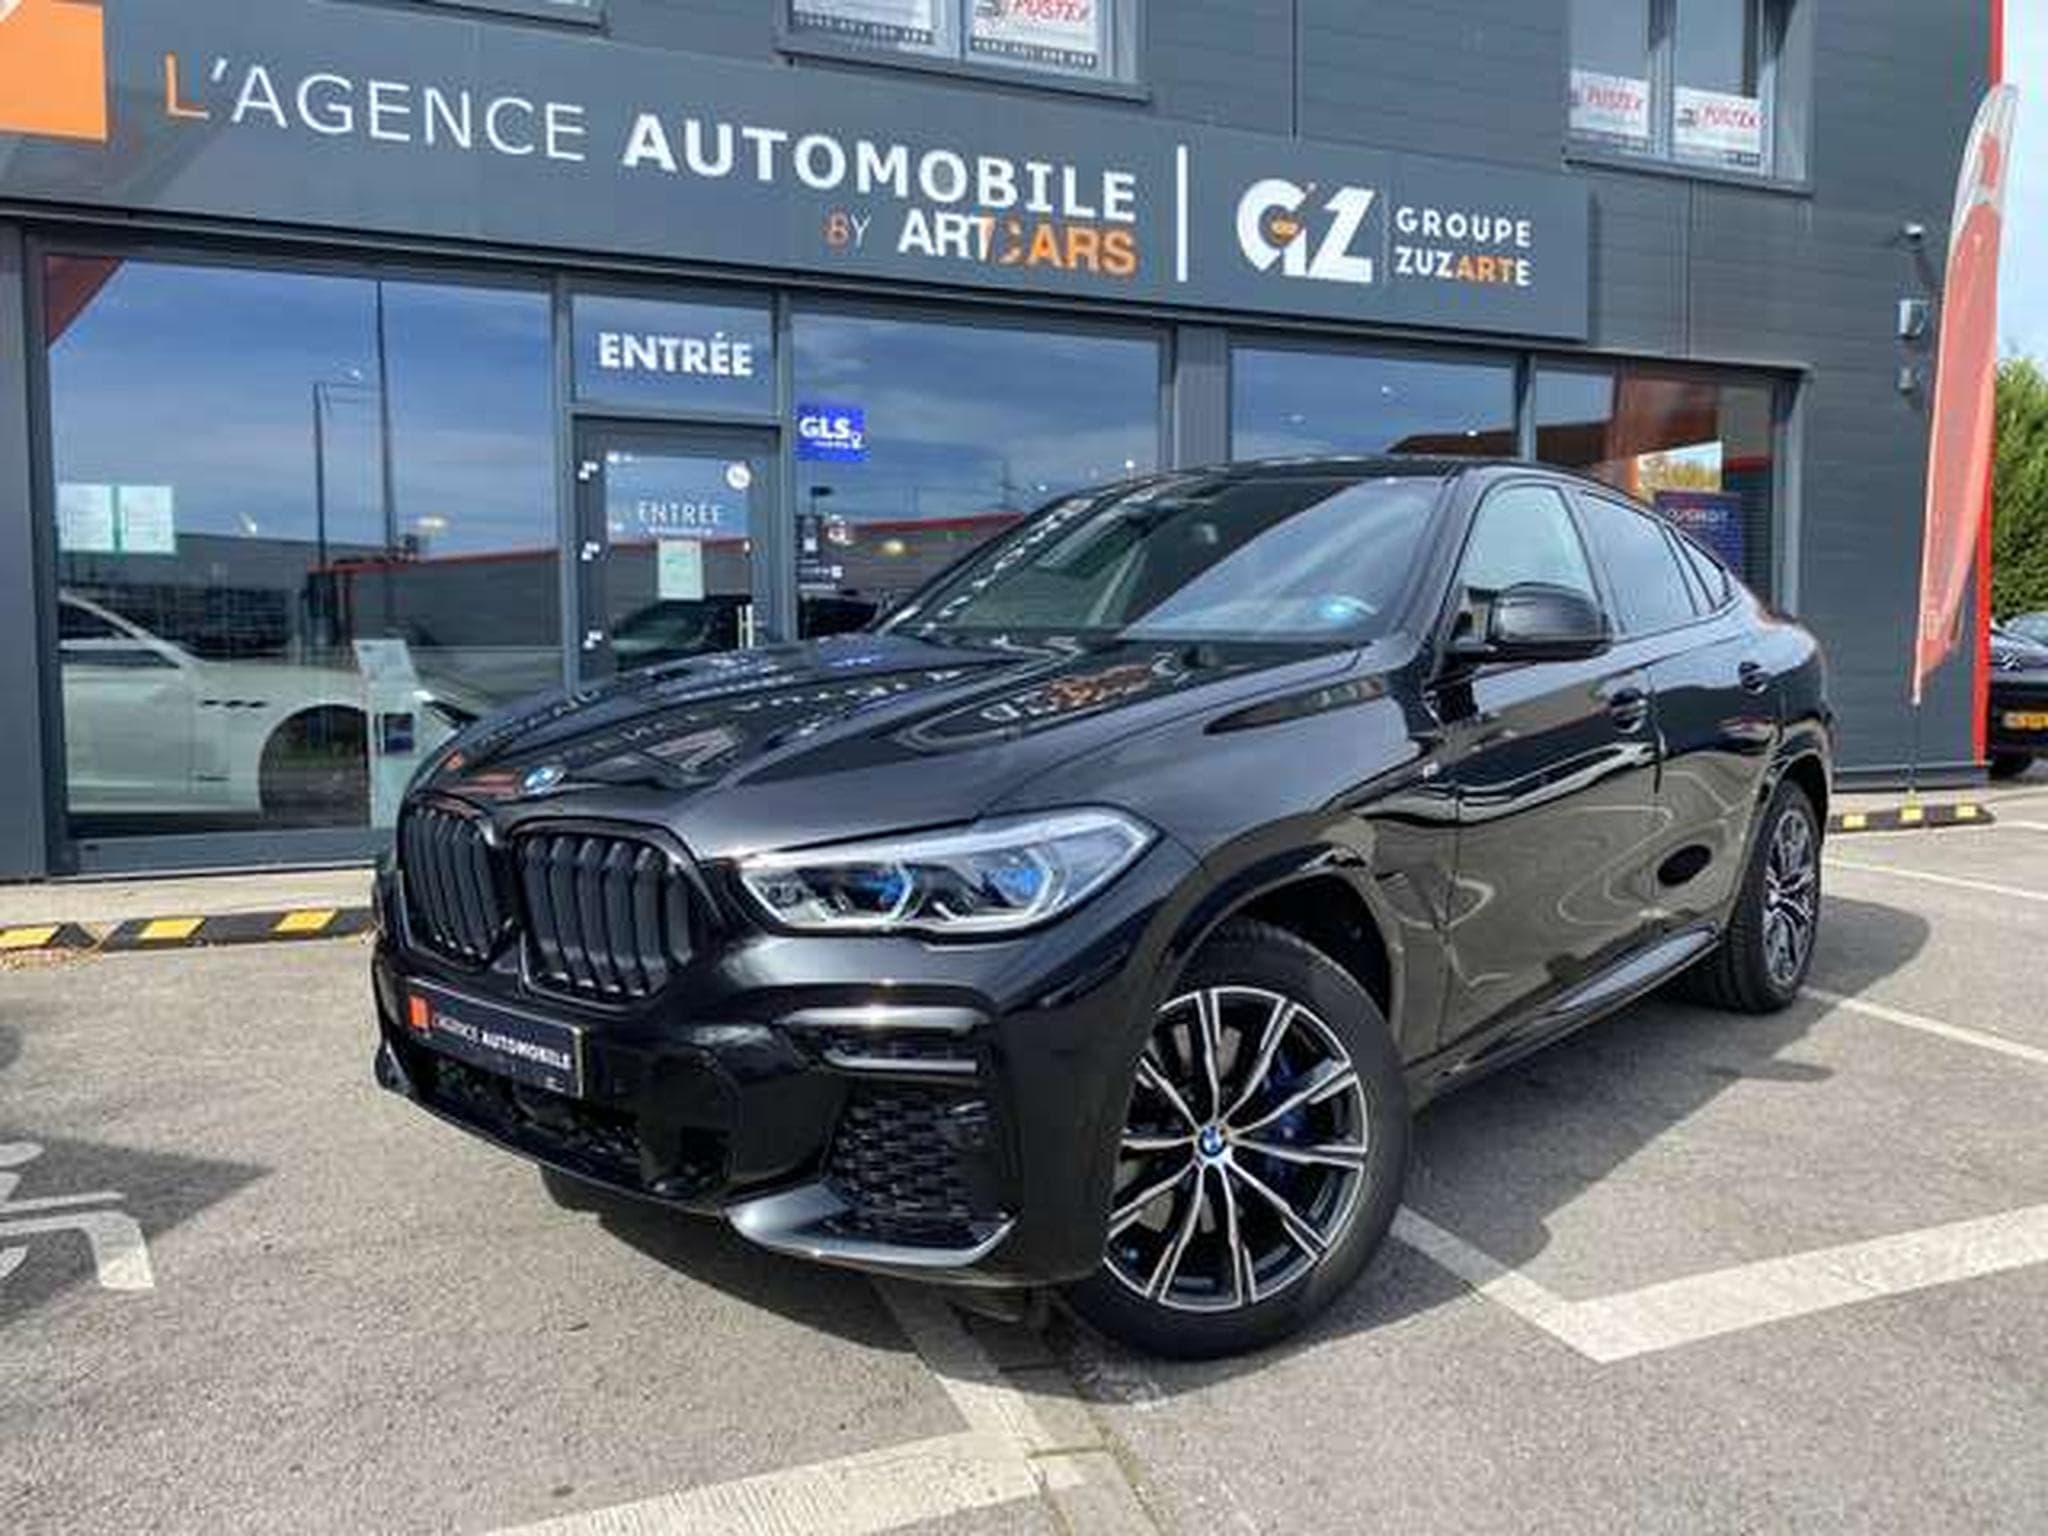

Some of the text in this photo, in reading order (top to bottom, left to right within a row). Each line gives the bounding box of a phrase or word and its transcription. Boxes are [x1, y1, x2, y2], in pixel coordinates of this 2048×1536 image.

[164, 52, 1137, 222] L'AGENCE AUTOMOBILE
[825, 212, 872, 250] BY
[1396, 206, 1532, 248] GROUPE
[1396, 246, 1532, 286] ZUZARTE
[600, 331, 753, 376] ENTRÉE
[799, 416, 851, 438] GLS
